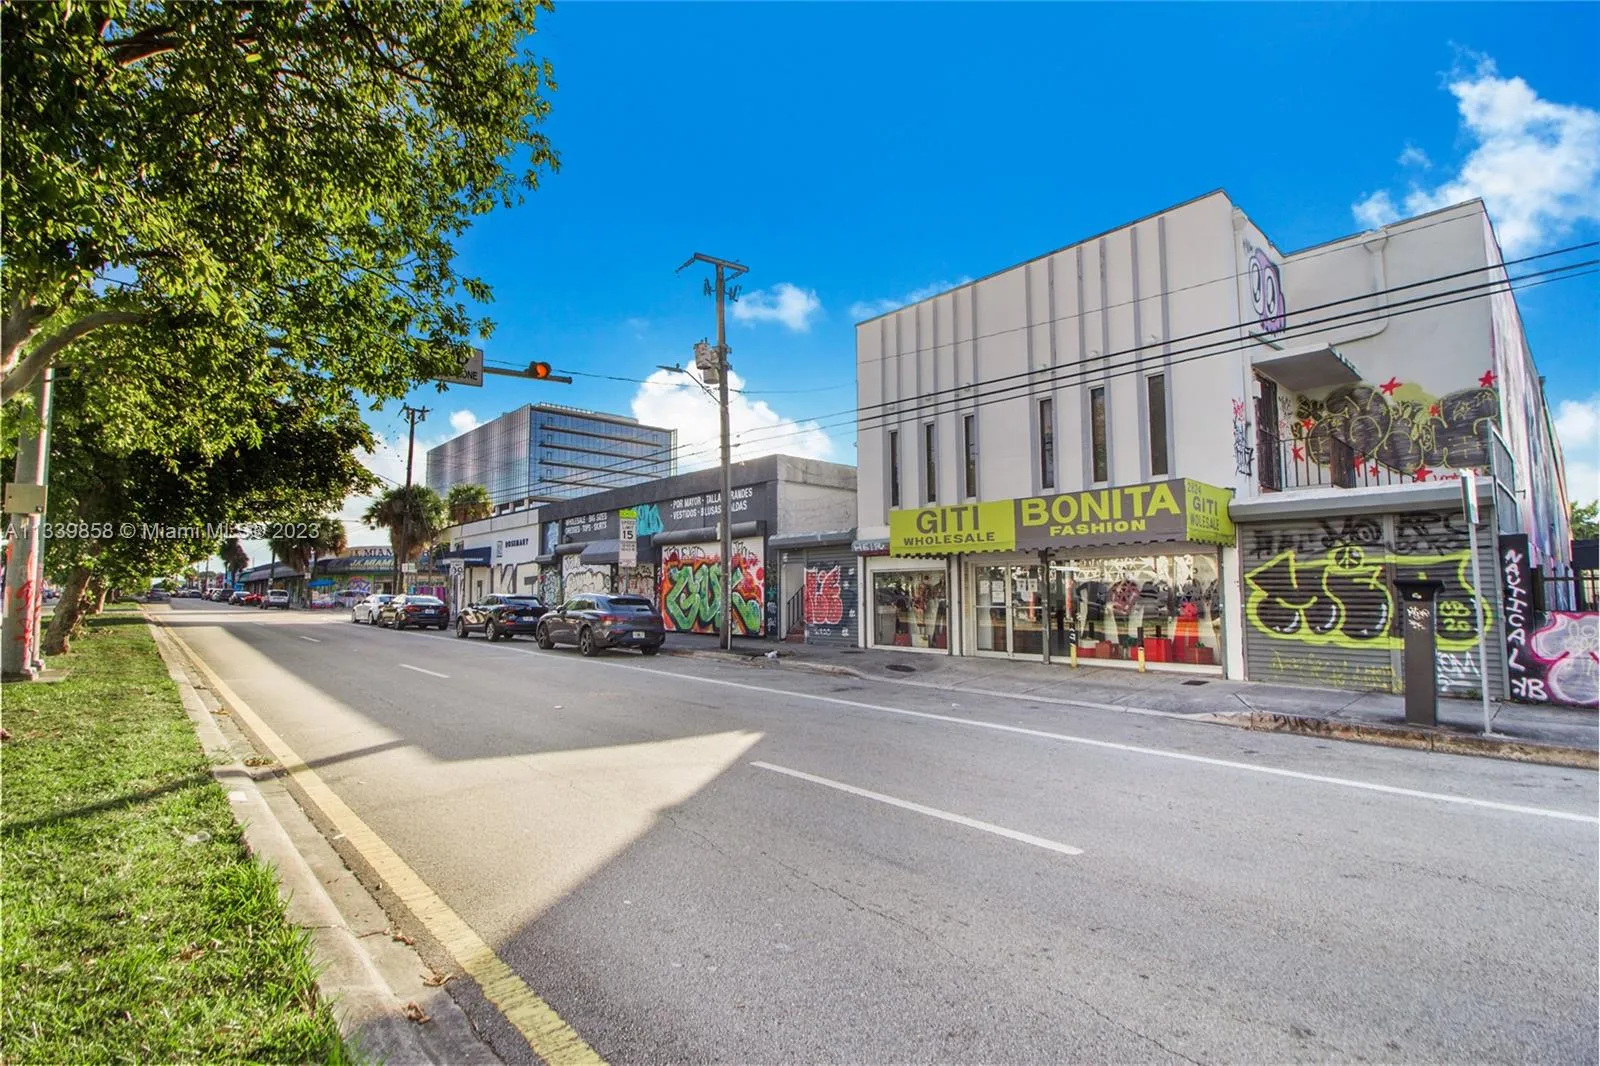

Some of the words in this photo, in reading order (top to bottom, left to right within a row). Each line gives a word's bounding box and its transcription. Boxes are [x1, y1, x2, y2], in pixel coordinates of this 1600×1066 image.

[672, 499, 683, 509] POR
[684, 496, 702, 507] MAYOR
[706, 493, 721, 504] TALLA
[731, 488, 753, 500] RANDES
[1021, 483, 1181, 527] BONITA
[1192, 496, 1218, 516] GITI
[673, 508, 697, 520] VESTIDOS
[701, 505, 722, 517] BLUSAS
[916, 505, 980, 534] GITI
[622, 530, 634, 540] 15
[1050, 519, 1147, 537] FASHION
[903, 531, 995, 546] WHOLESALE
